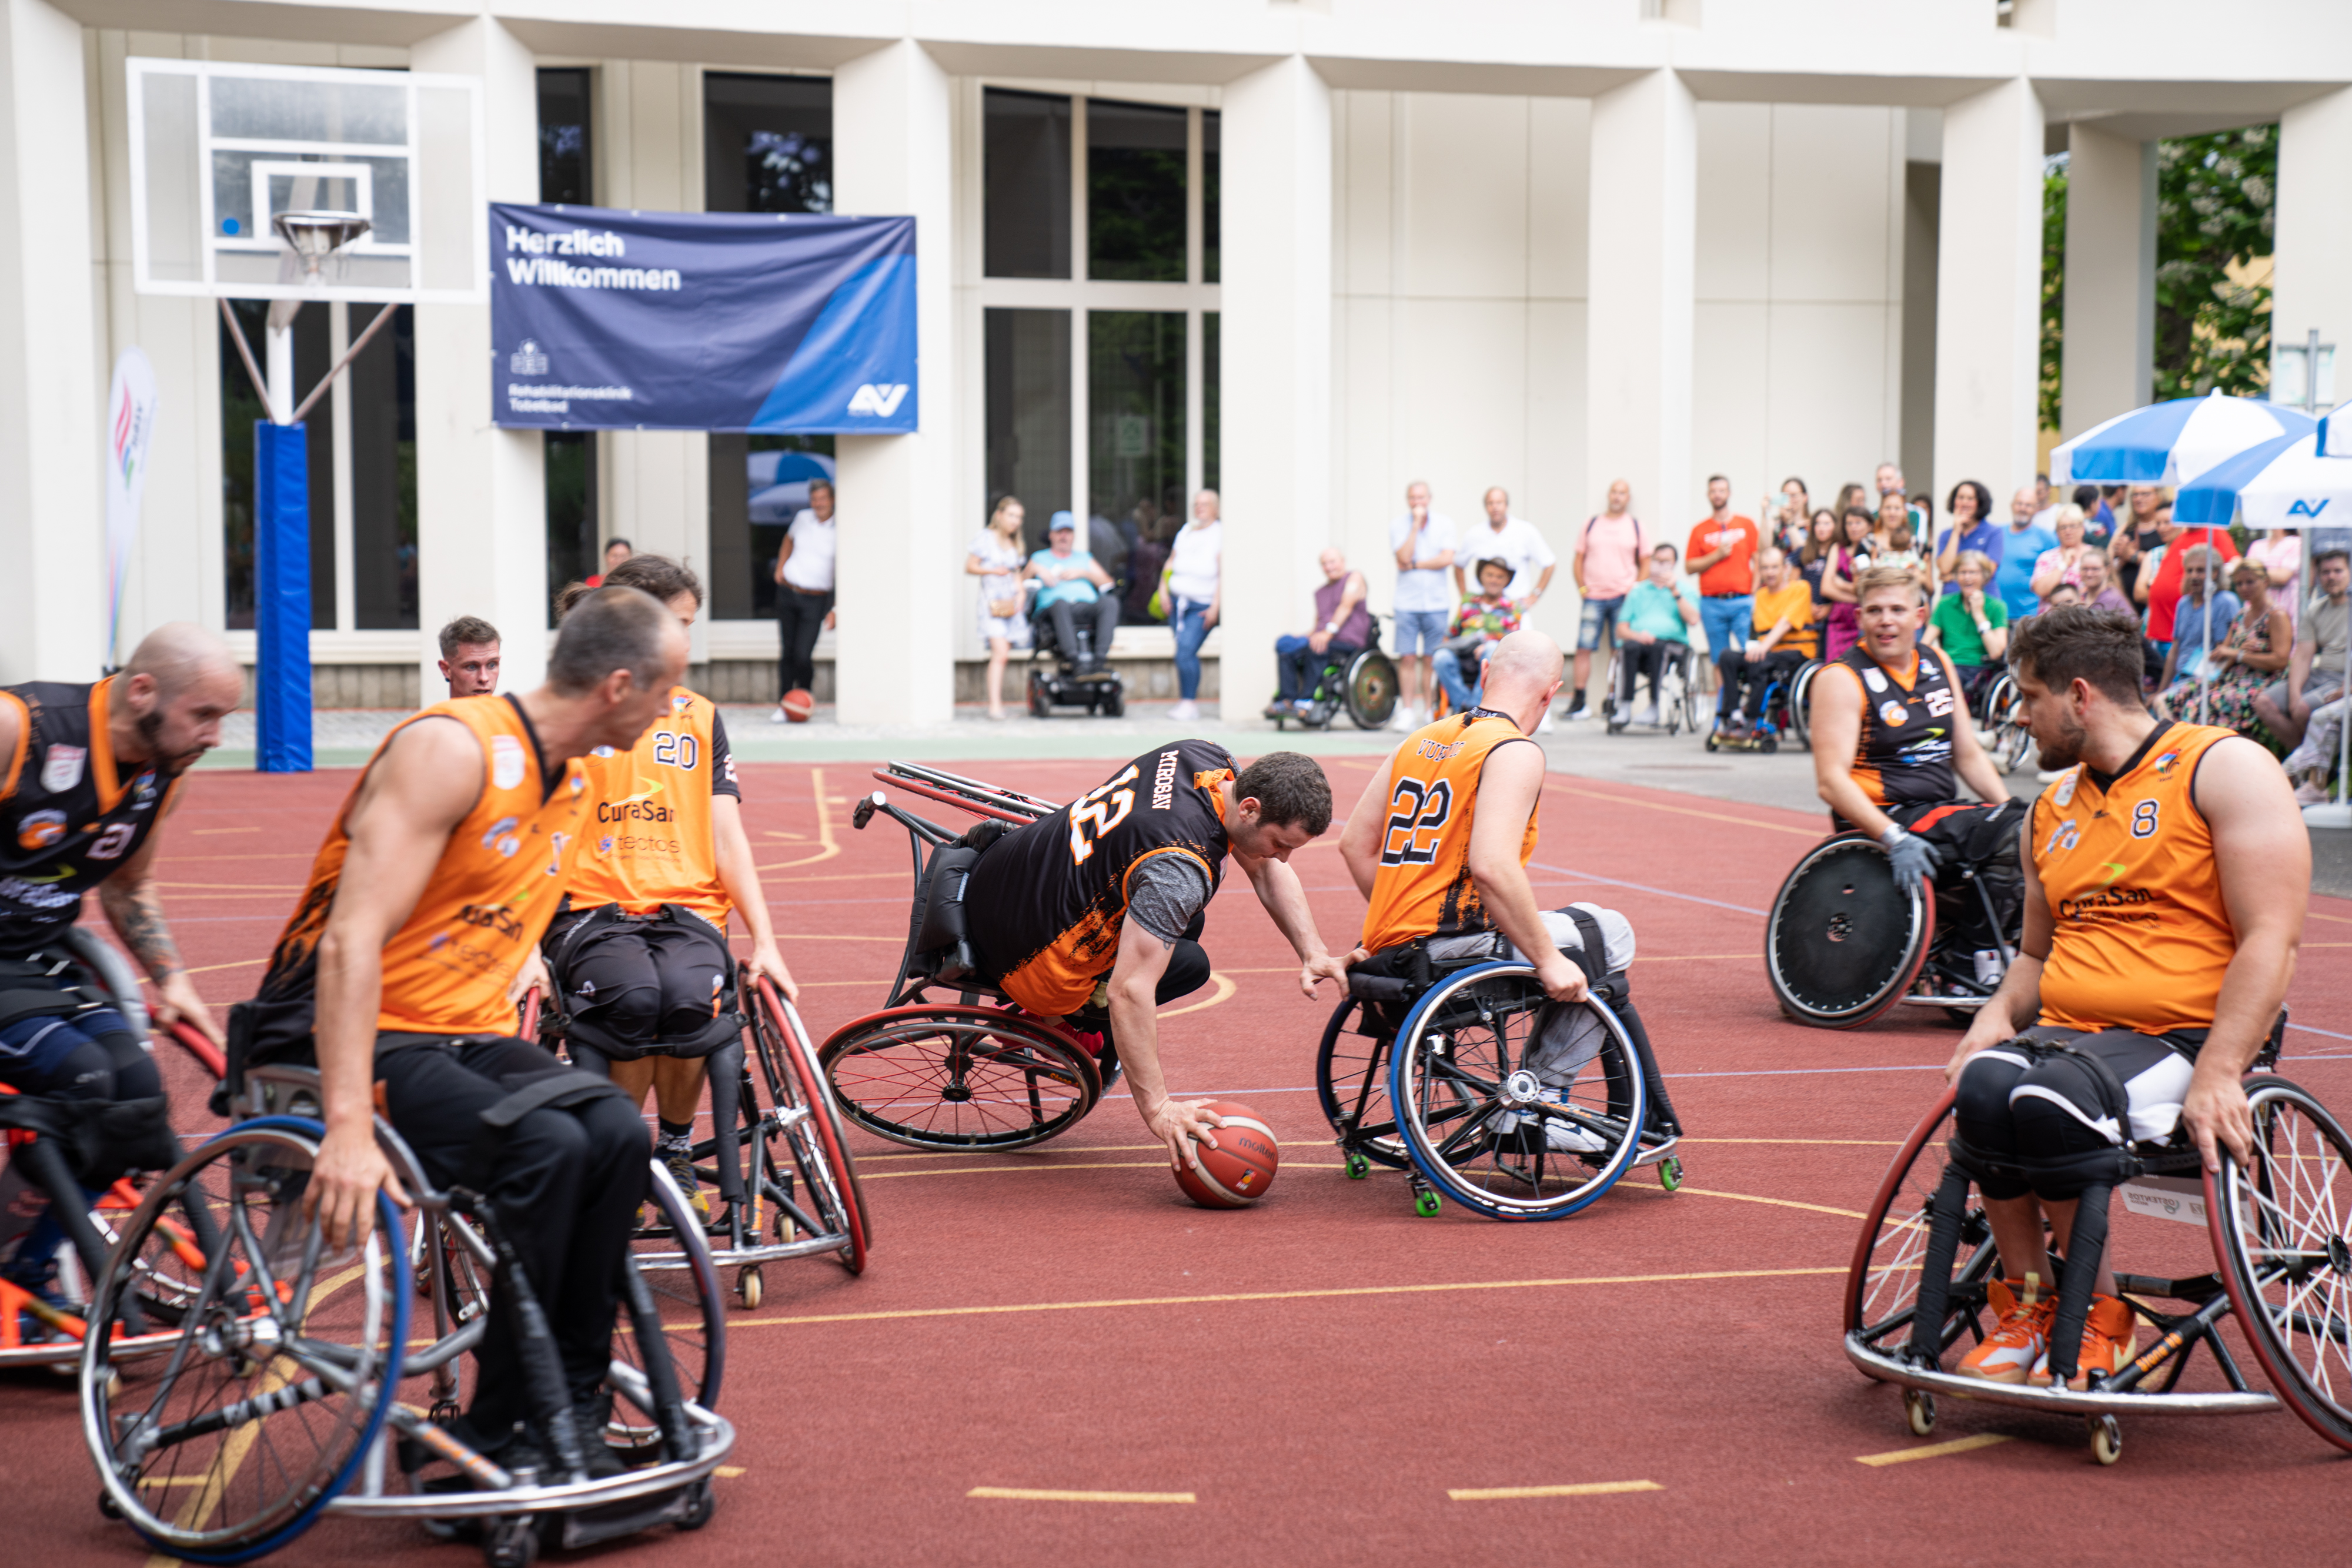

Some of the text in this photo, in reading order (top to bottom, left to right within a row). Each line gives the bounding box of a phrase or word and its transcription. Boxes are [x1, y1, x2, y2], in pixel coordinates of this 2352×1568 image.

[506, 225, 625, 257] Herzlich
[506, 258, 681, 291] Willkommen
[652, 731, 699, 771] 20
[1152, 750, 1179, 810] MIROSAV
[1070, 764, 1140, 865] 12
[1379, 775, 1454, 867] 22
[2130, 798, 2160, 839] 8
[618, 835, 680, 853] tectos
[2059, 886, 2154, 918] CuraSan
[1239, 1137, 1275, 1162] molten
